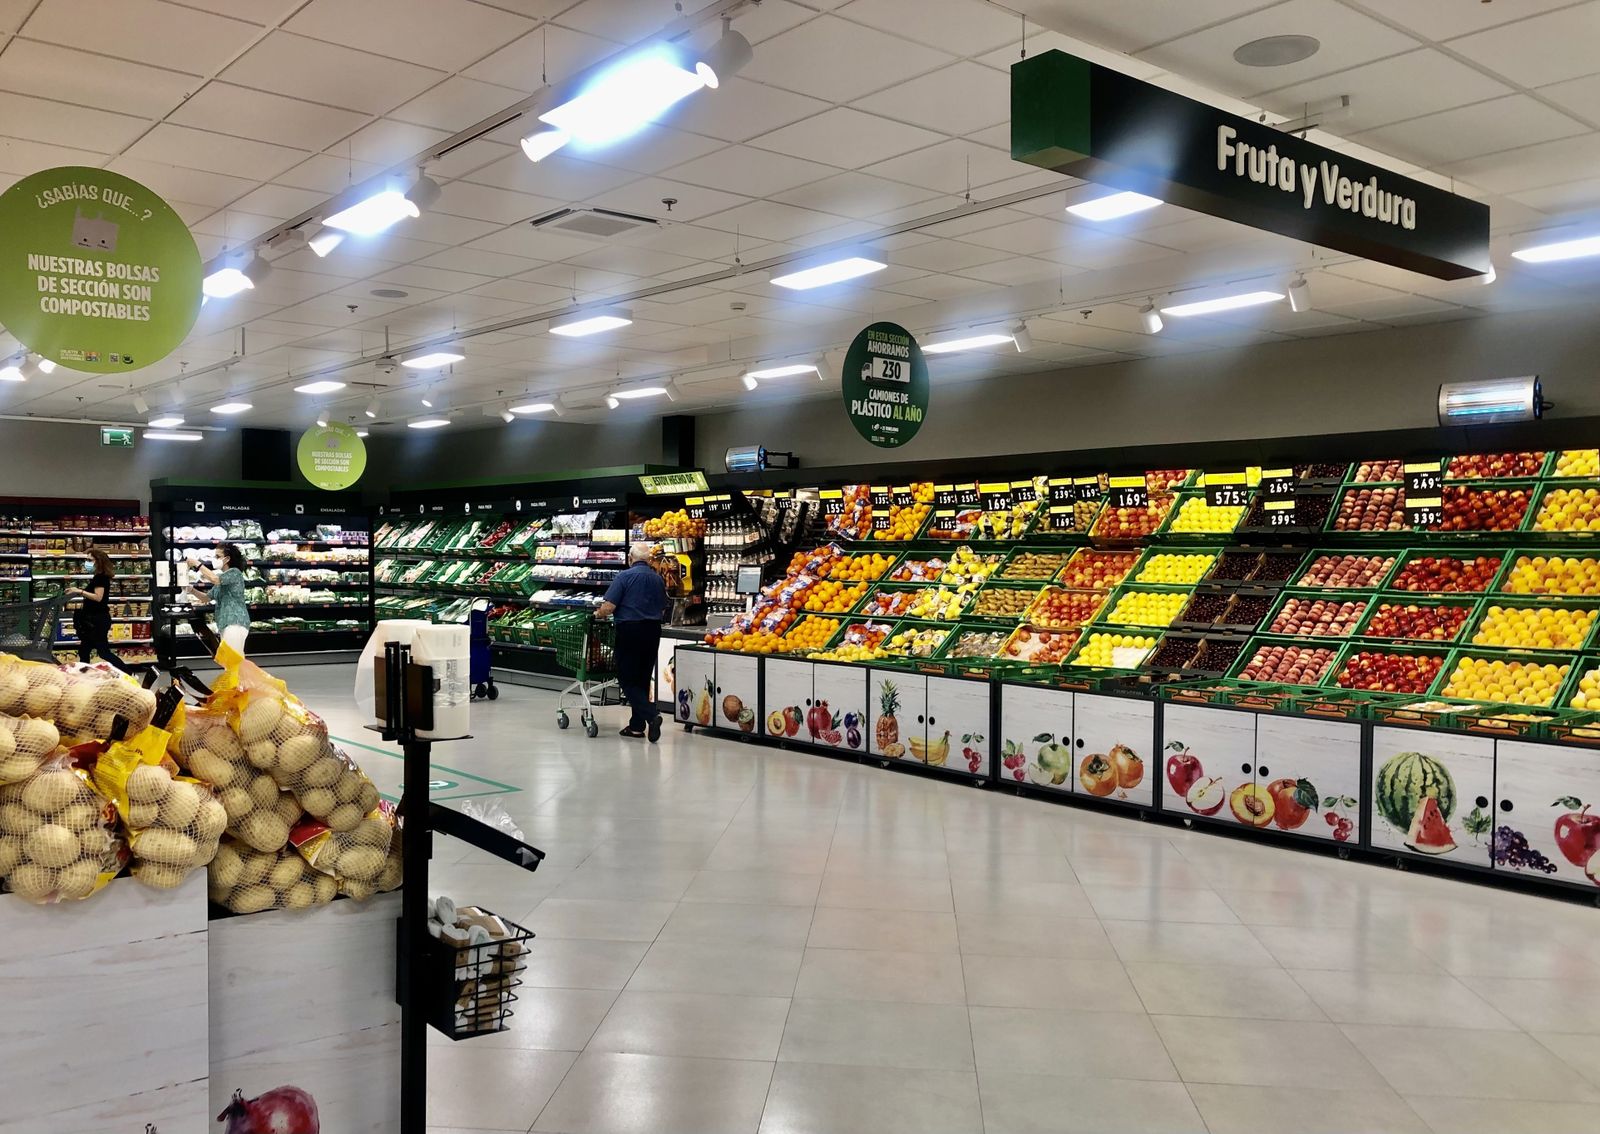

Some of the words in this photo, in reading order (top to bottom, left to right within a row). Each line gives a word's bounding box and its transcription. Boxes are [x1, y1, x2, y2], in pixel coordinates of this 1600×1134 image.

[1218, 125, 1295, 192] Fruta
[1301, 164, 1317, 209] y
[1321, 160, 1416, 231] Verdura
[36, 182, 99, 209] ¿SABÍAS
[28, 254, 104, 277] NUESTRAS
[106, 262, 160, 283] BOLSAS
[38, 276, 57, 292] DE
[61, 278, 119, 299] SECCIÓN
[123, 285, 151, 302] SON
[41, 297, 150, 322] COMPOSTABLES
[868, 330, 875, 340] EN
[876, 332, 888, 342] ESTA
[868, 341, 909, 358] AHORRAMOS
[882, 360, 901, 380] 230
[869, 389, 900, 403] CAMIONES
[901, 394, 909, 404] DE
[852, 399, 891, 419] PLÁSTICO
[893, 405, 903, 421] AL
[905, 405, 922, 422] AÑO
